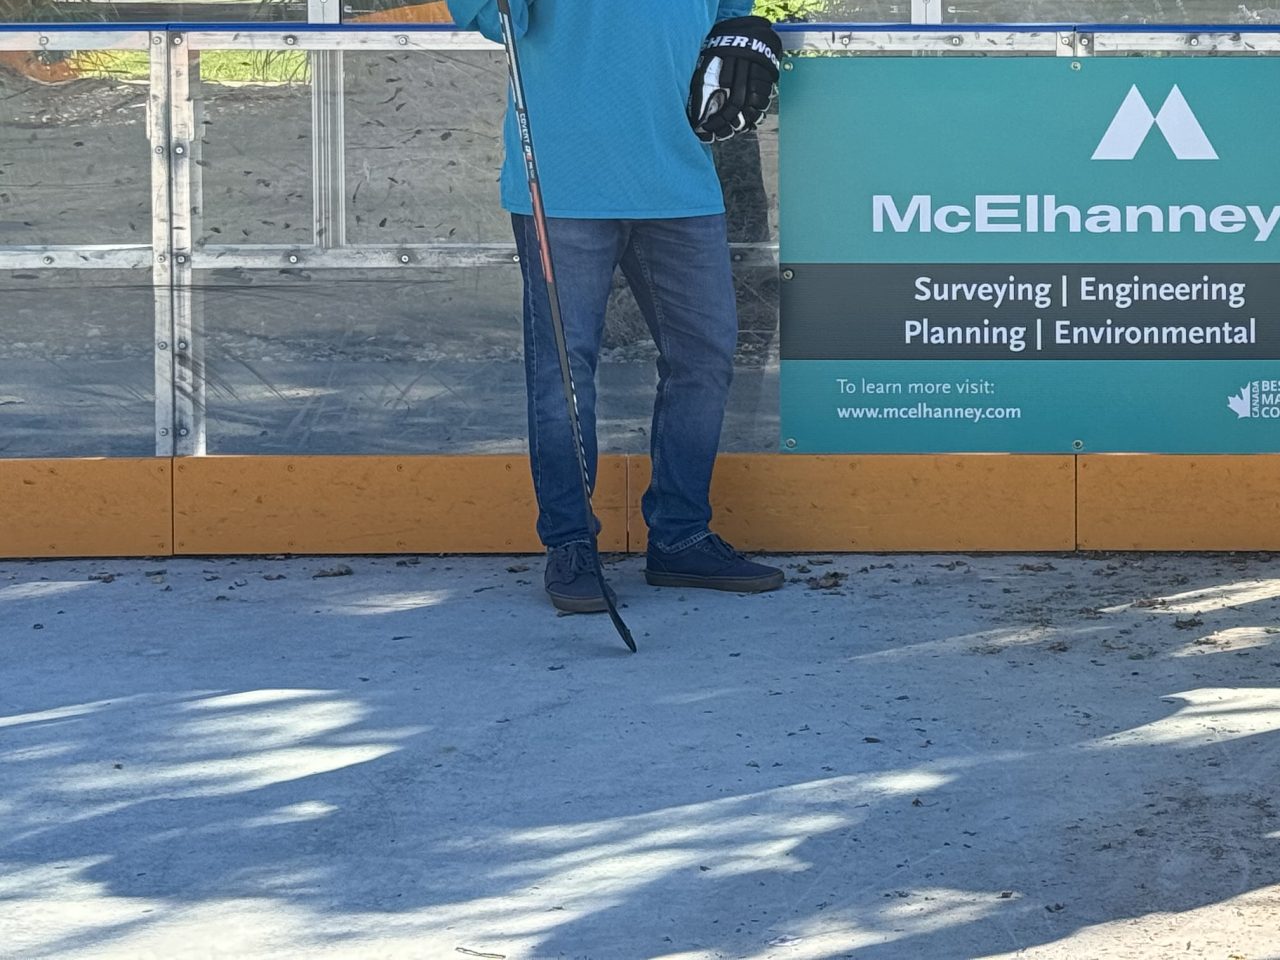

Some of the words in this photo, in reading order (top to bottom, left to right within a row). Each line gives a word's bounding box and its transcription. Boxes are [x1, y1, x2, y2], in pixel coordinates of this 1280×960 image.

[518, 113, 530, 144] COVERT
[914, 275, 1052, 309] Surveying
[1080, 274, 1246, 309] Engineering
[905, 318, 1027, 352] Planning
[1055, 318, 1256, 345] Environmental
[836, 379, 857, 394] To
[862, 378, 902, 394] learn
[908, 383, 951, 394] more
[955, 379, 995, 394] visit:
[1251, 380, 1260, 418] CANADA
[837, 403, 1022, 423] www.mcelhanney.com
